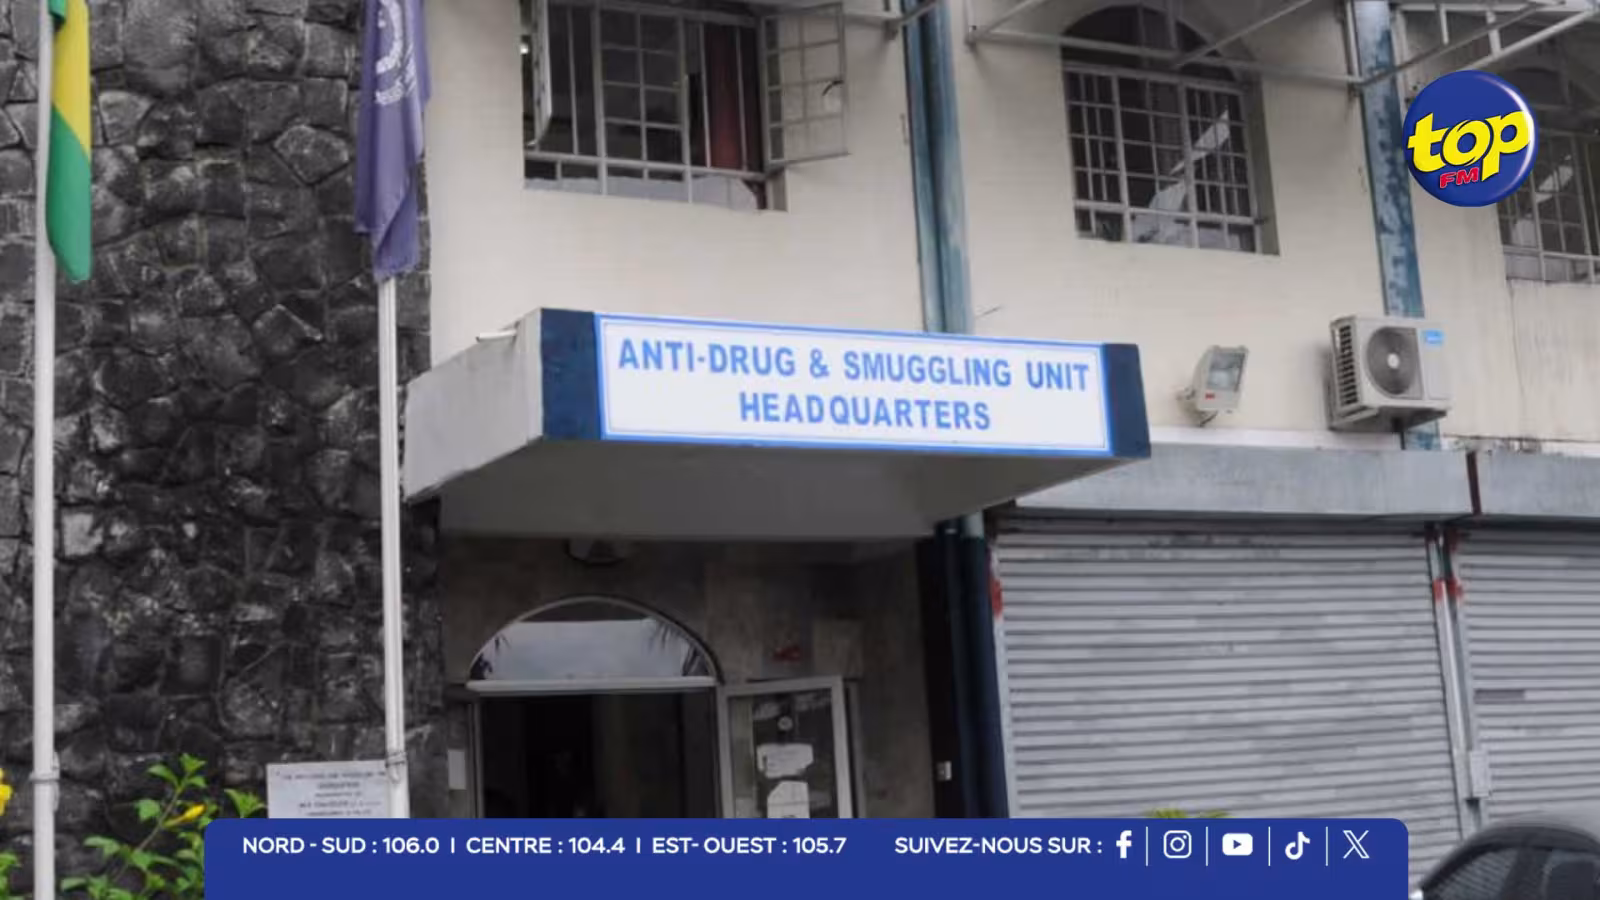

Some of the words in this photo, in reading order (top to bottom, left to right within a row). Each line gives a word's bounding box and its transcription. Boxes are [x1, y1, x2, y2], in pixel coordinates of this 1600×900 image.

[618, 338, 796, 378] ANTI-DRUG
[809, 348, 831, 380] &
[843, 350, 1013, 388] SMUGGLING
[1026, 362, 1090, 391] UNIT
[739, 391, 992, 431] HEADQUARTERS
